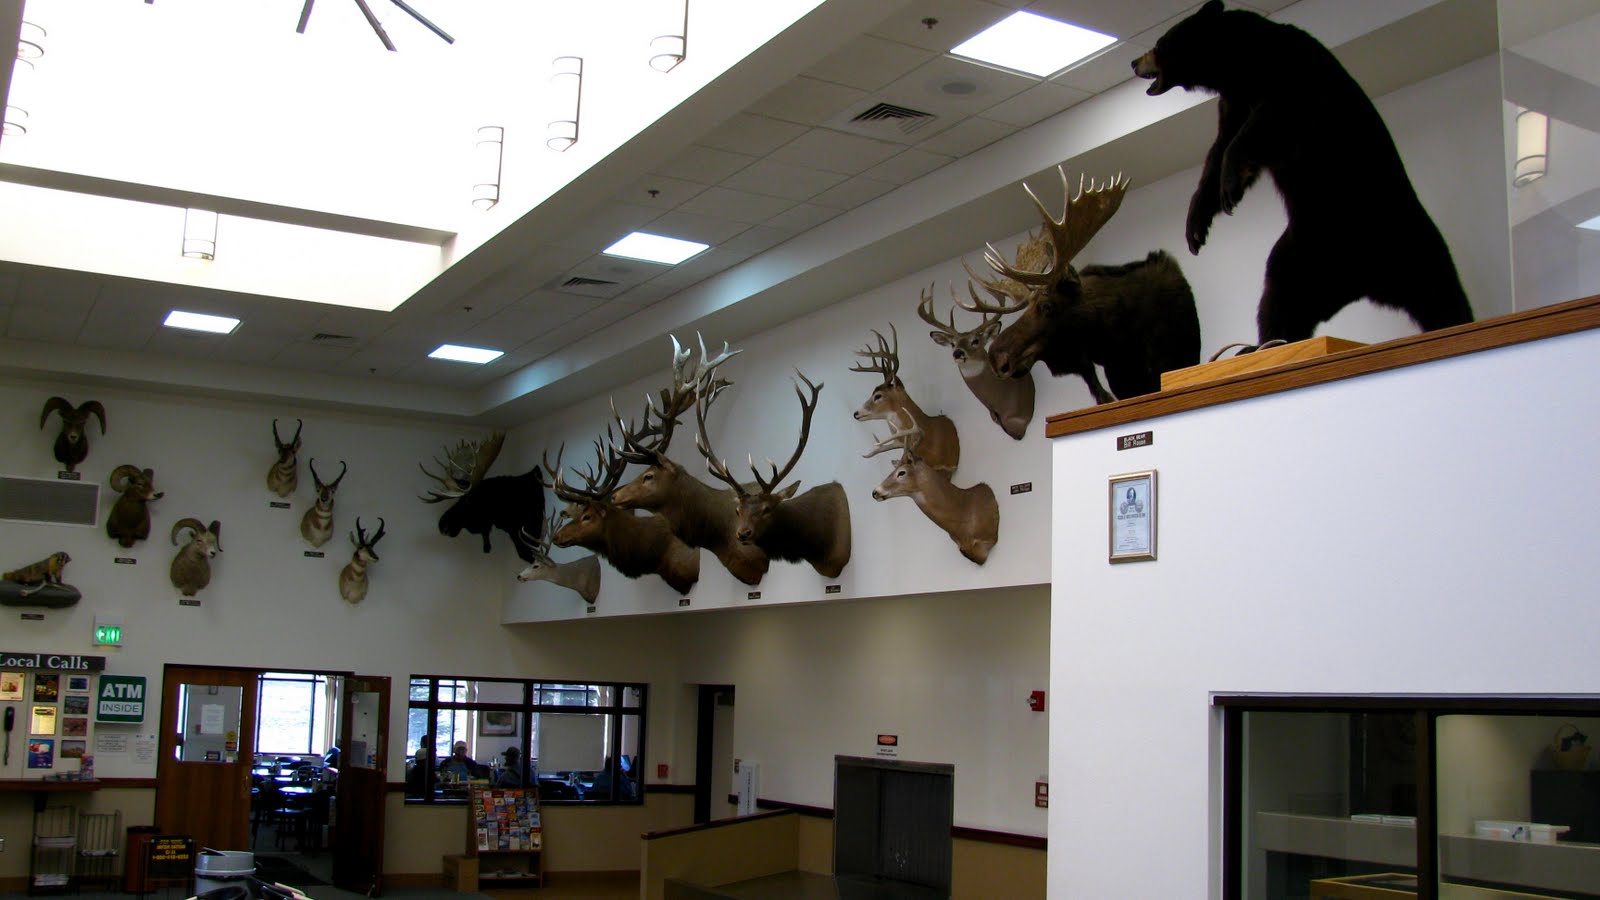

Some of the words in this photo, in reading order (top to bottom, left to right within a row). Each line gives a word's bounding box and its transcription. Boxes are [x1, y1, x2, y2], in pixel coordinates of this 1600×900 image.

[0, 653, 41, 668] Local
[47, 655, 89, 670] Calls
[102, 683, 142, 699] ATM
[102, 703, 140, 713] INSIDE
